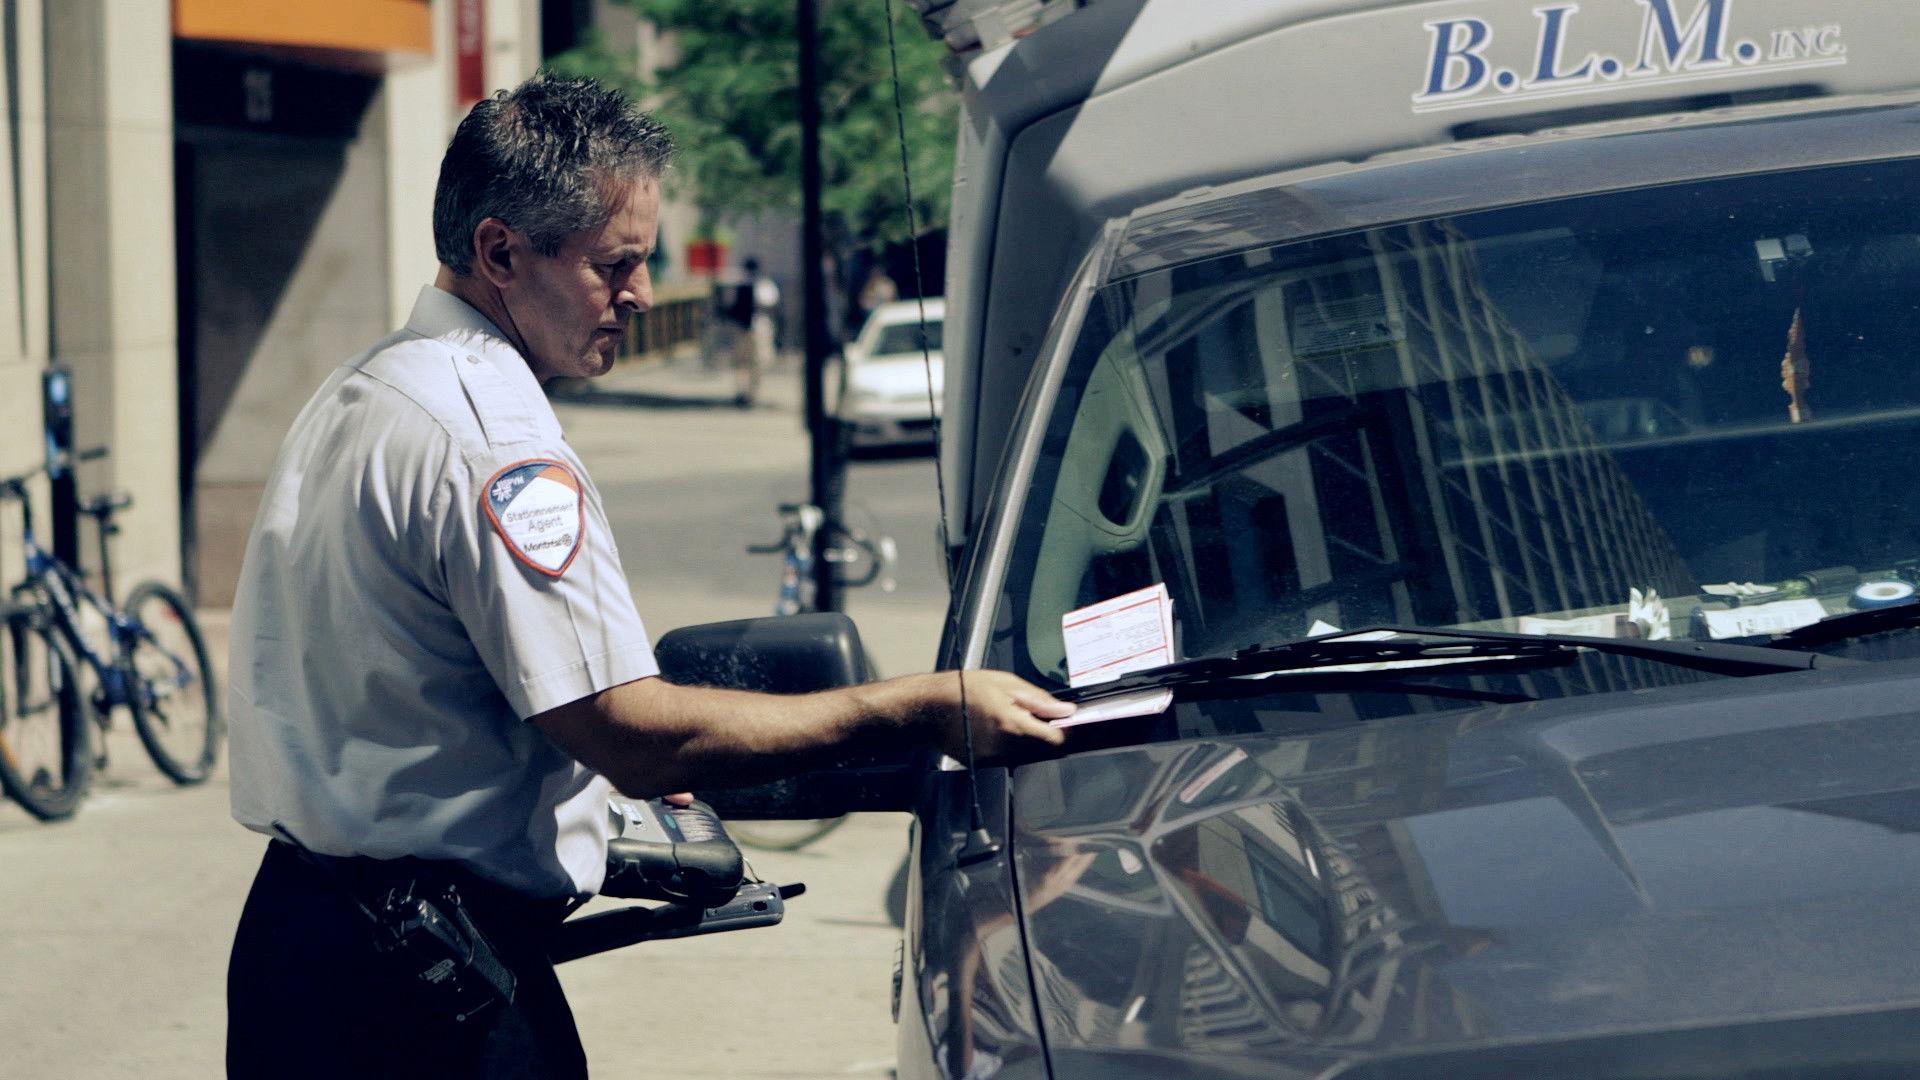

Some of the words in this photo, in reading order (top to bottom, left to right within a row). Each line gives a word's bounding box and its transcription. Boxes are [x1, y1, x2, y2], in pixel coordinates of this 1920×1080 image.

[1412, 0, 1761, 103] B.L.M.
[1767, 25, 1847, 61] INC.
[528, 516, 563, 533] Agent
